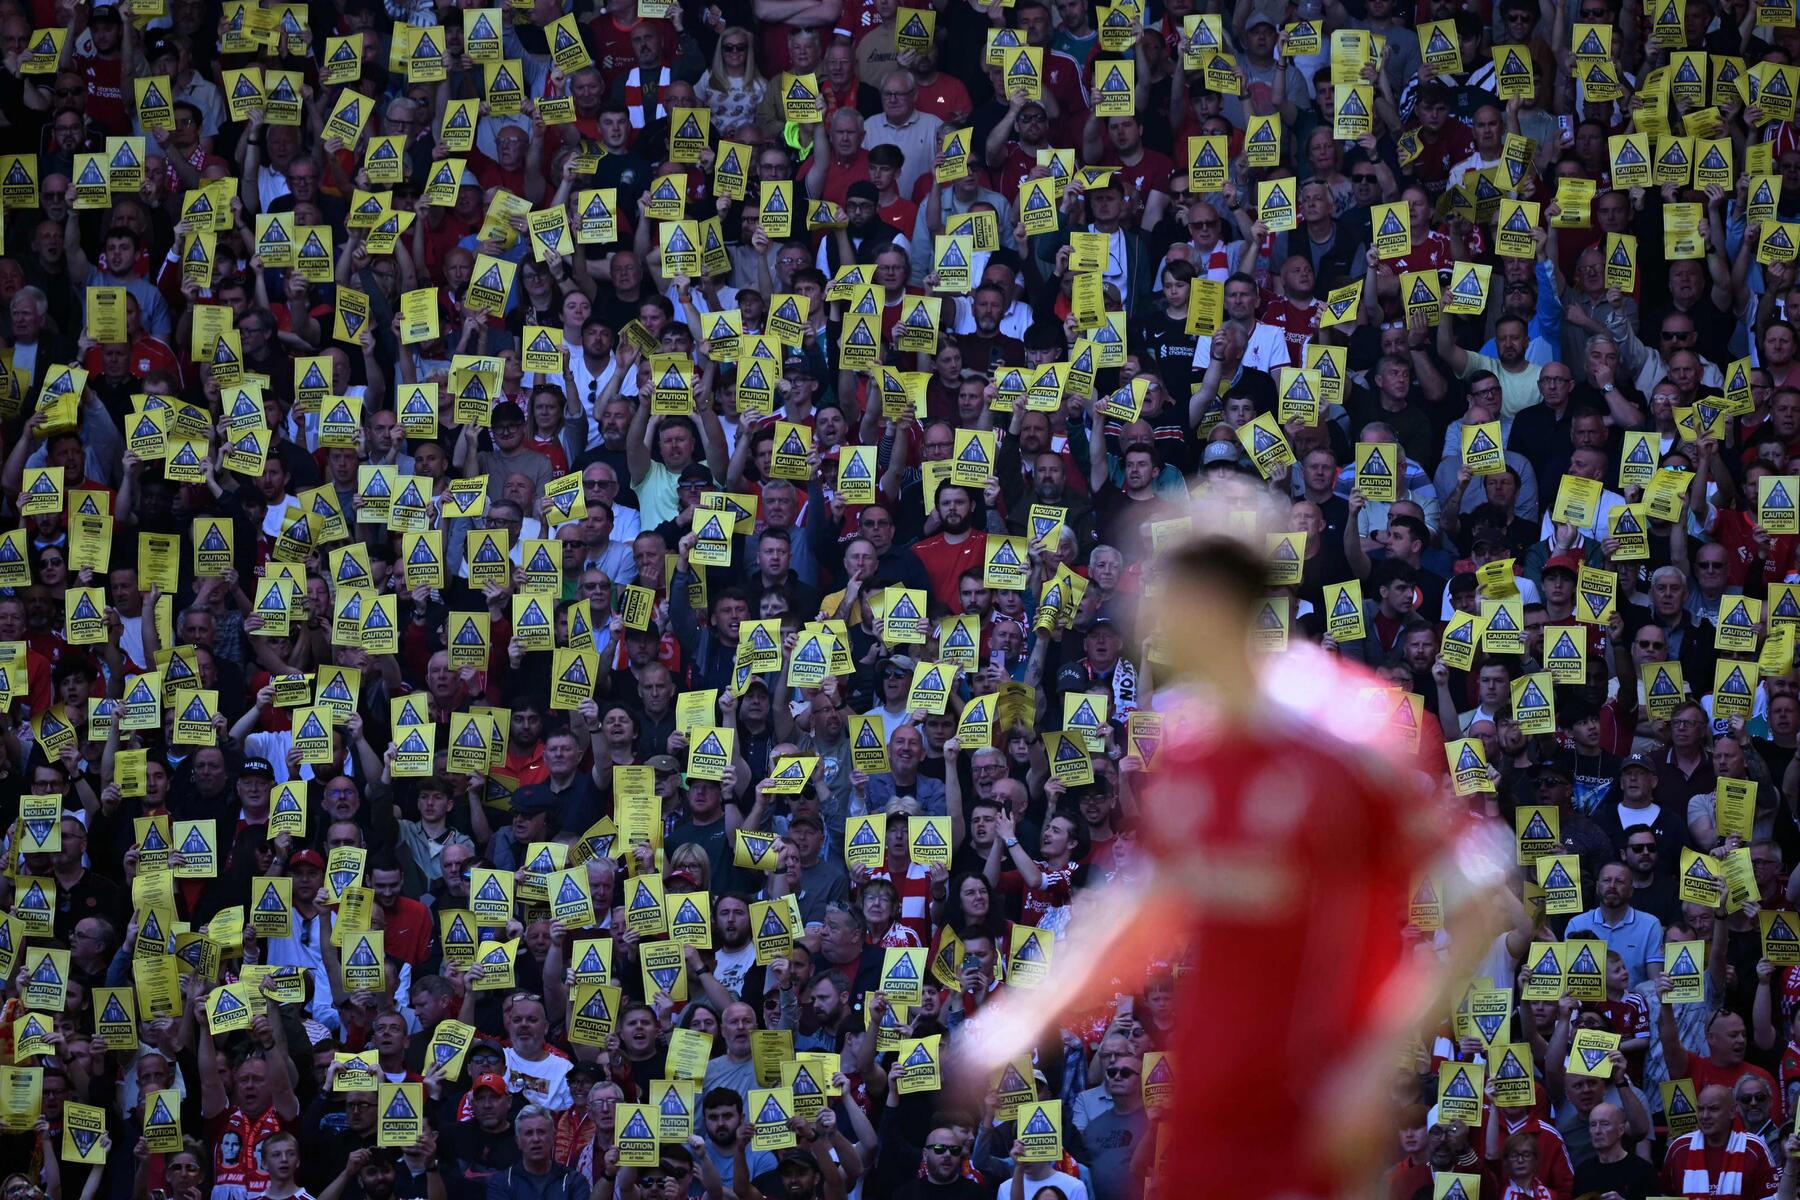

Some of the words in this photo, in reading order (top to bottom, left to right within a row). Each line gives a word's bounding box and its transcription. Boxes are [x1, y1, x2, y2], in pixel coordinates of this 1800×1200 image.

[899, 38, 927, 46] CAUTION
[1288, 38, 1316, 46] CAUTION
[556, 46, 581, 62] CAUTION
[234, 98, 262, 107] CAUTION
[491, 94, 520, 102] CAUTION
[540, 102, 568, 111] CAUTION
[142, 110, 168, 119] CAUTION
[331, 120, 356, 136] CAUTION
[1617, 166, 1646, 175] CAUTION
[1025, 210, 1051, 221] CAUTION
[1263, 209, 1290, 219] CAUTION
[534, 218, 562, 230] CAUTION
[582, 221, 611, 229] CAUTION
[975, 218, 984, 247] CAUTION
[1378, 235, 1406, 246] CAUTION
[1502, 234, 1531, 243] CAUTION
[1763, 247, 1792, 256] CAUTION
[666, 255, 695, 263] CAUTION
[473, 289, 502, 302] CAUTION
[341, 300, 364, 313] CAUTION
[772, 320, 800, 334] CAUTION
[740, 391, 768, 400] CAUTION
[460, 402, 487, 411] CAUTION
[1284, 403, 1313, 411] CAUTION
[133, 437, 162, 448] CAUTION
[1258, 444, 1286, 464] CAUTION
[1468, 452, 1498, 463] CAUTION
[777, 458, 806, 466] CAUTION
[958, 464, 987, 473] CAUTION
[394, 509, 424, 518] CAUTION
[281, 540, 309, 554] CAUTION
[408, 566, 437, 575] CAUTION
[1583, 582, 1611, 593] CAUTION
[627, 591, 639, 622] CAUTION
[72, 621, 101, 630] CAUTION
[1332, 616, 1358, 628] CAUTION
[362, 630, 391, 640] CAUTION
[518, 628, 548, 636] CAUTION
[1722, 628, 1752, 637] CAUTION
[1445, 642, 1470, 654] CAUTION
[794, 665, 824, 673] CAUTION
[559, 684, 589, 696] CAUTION
[1651, 698, 1680, 706] CAUTION
[1719, 696, 1749, 706] CAUTION
[1518, 710, 1549, 719] CAUTION
[960, 725, 986, 734] CAUTION
[45, 731, 73, 747] CAUTION
[297, 741, 327, 749] CAUTION
[454, 750, 485, 759] CAUTION
[694, 757, 725, 766] CAUTION
[1056, 761, 1086, 772] CAUTION
[849, 847, 878, 856] CAUTION
[476, 903, 507, 911] CAUTION
[556, 903, 587, 916] CAUTION
[630, 910, 659, 921] CAUTION
[675, 926, 705, 935] CAUTION
[760, 937, 790, 949] CAUTION
[647, 956, 679, 966] CAUTION
[576, 976, 605, 984] CAUTION
[28, 985, 60, 995] CAUTION
[214, 1009, 246, 1024] CAUTION
[576, 1020, 609, 1032] CAUTION
[1496, 1082, 1528, 1091] CAUTION
[1444, 1100, 1476, 1109] CAUTION
[70, 1117, 100, 1128] CAUTION
[1023, 1137, 1055, 1146] CAUTION
